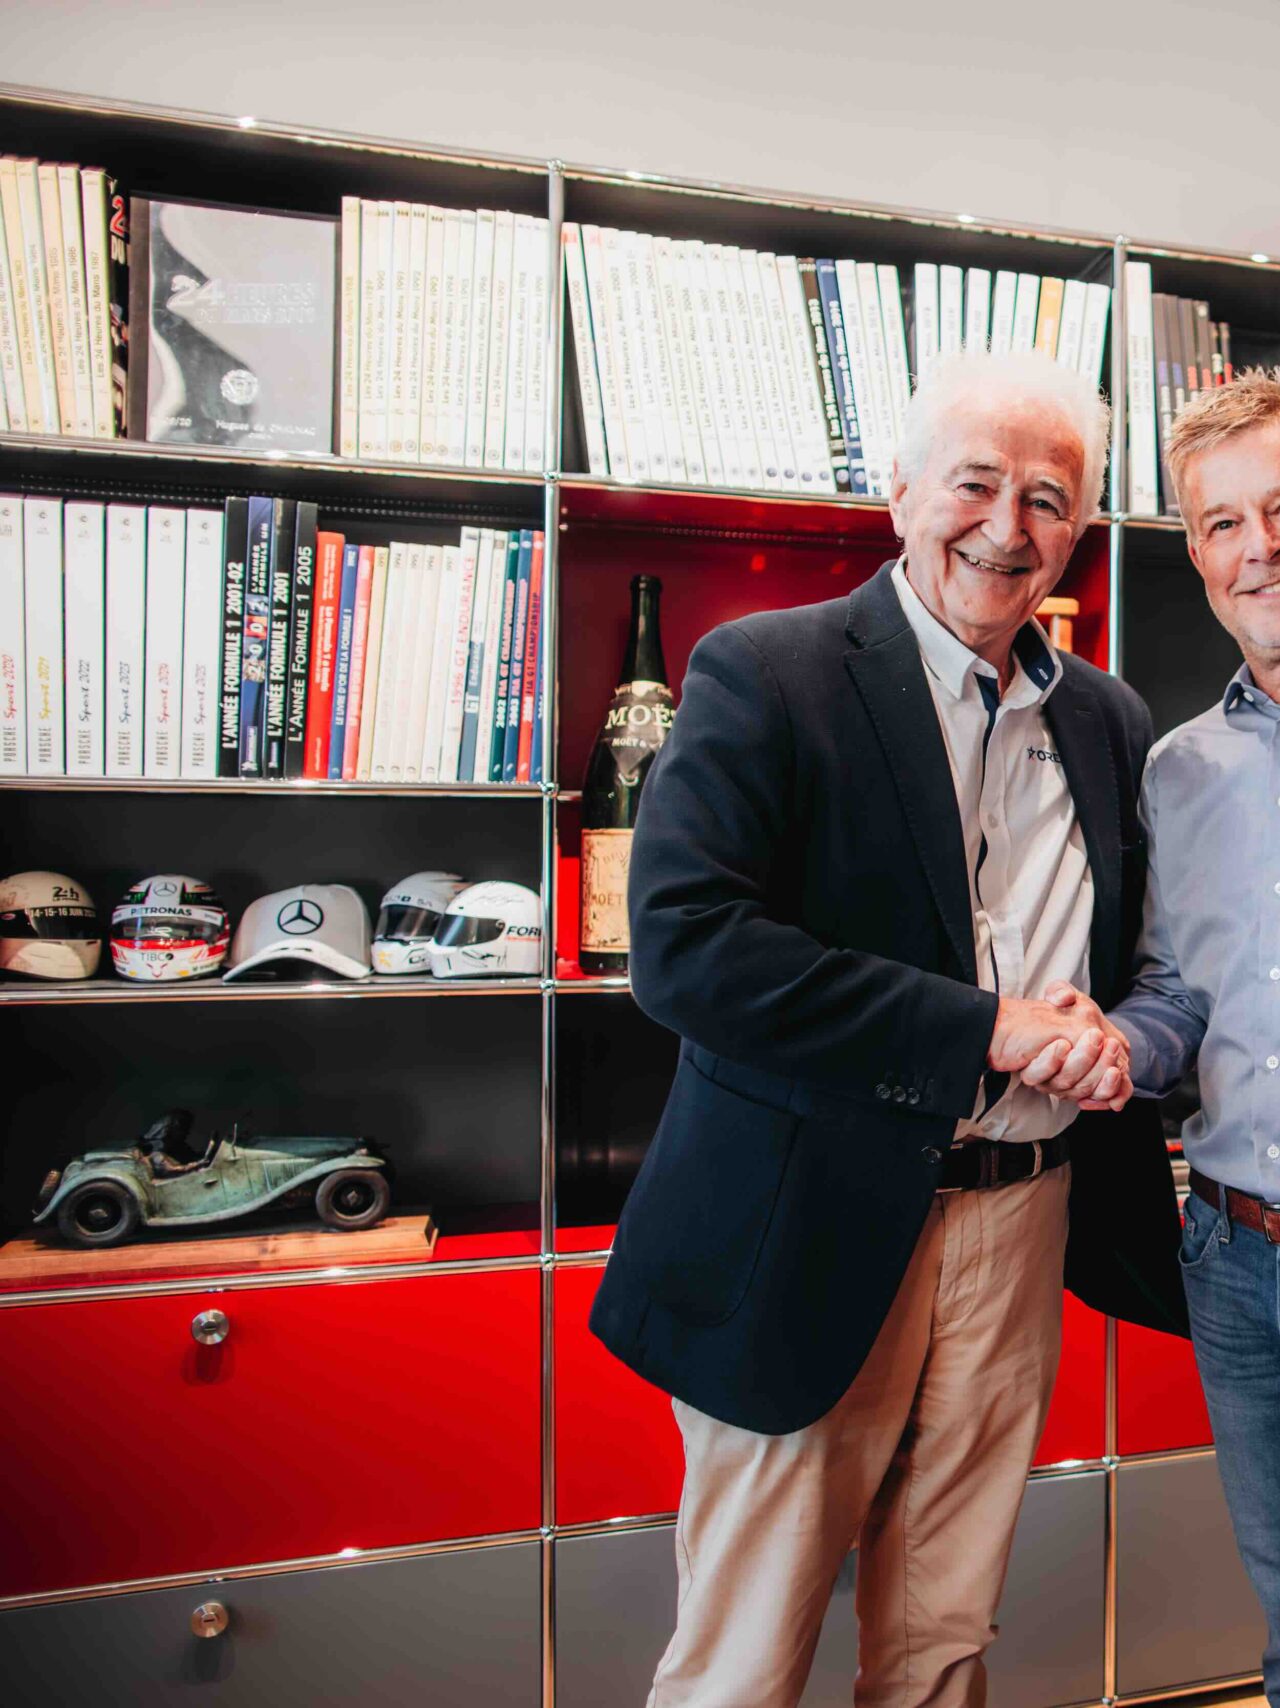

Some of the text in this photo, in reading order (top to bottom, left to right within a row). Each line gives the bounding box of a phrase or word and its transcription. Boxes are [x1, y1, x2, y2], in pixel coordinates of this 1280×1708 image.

[297, 546, 313, 586] 2005
[227, 562, 244, 614] 2001-02
[274, 571, 290, 603] 2001
[455, 557, 475, 643] ENDURANCE
[224, 632, 241, 692] FORMULE
[271, 621, 287, 681] FORMULE
[340, 651, 349, 661] LA
[340, 663, 348, 673] DE
[454, 650, 466, 666] GT
[3, 683, 16, 720] Sport
[339, 674, 348, 694] D'OR
[39, 684, 51, 720] Sport
[79, 686, 93, 722] Sport
[119, 688, 132, 724] Sport
[157, 688, 171, 724] Sport
[195, 690, 208, 725] Sport
[266, 683, 285, 736] L'ANNÉE
[337, 695, 346, 716] LIVRE
[219, 695, 239, 749] L'ANNÉE
[336, 716, 345, 725] LE
[3, 726, 17, 762] PORSCHE
[38, 727, 53, 763] PORSCHE
[78, 729, 92, 764] PORSCHE
[118, 731, 132, 766] PORSCHE
[156, 731, 169, 766] PORSCHE
[192, 732, 206, 767] PORSCHE
[130, 906, 192, 916] PTRONAS
[506, 926, 541, 937] FOR
